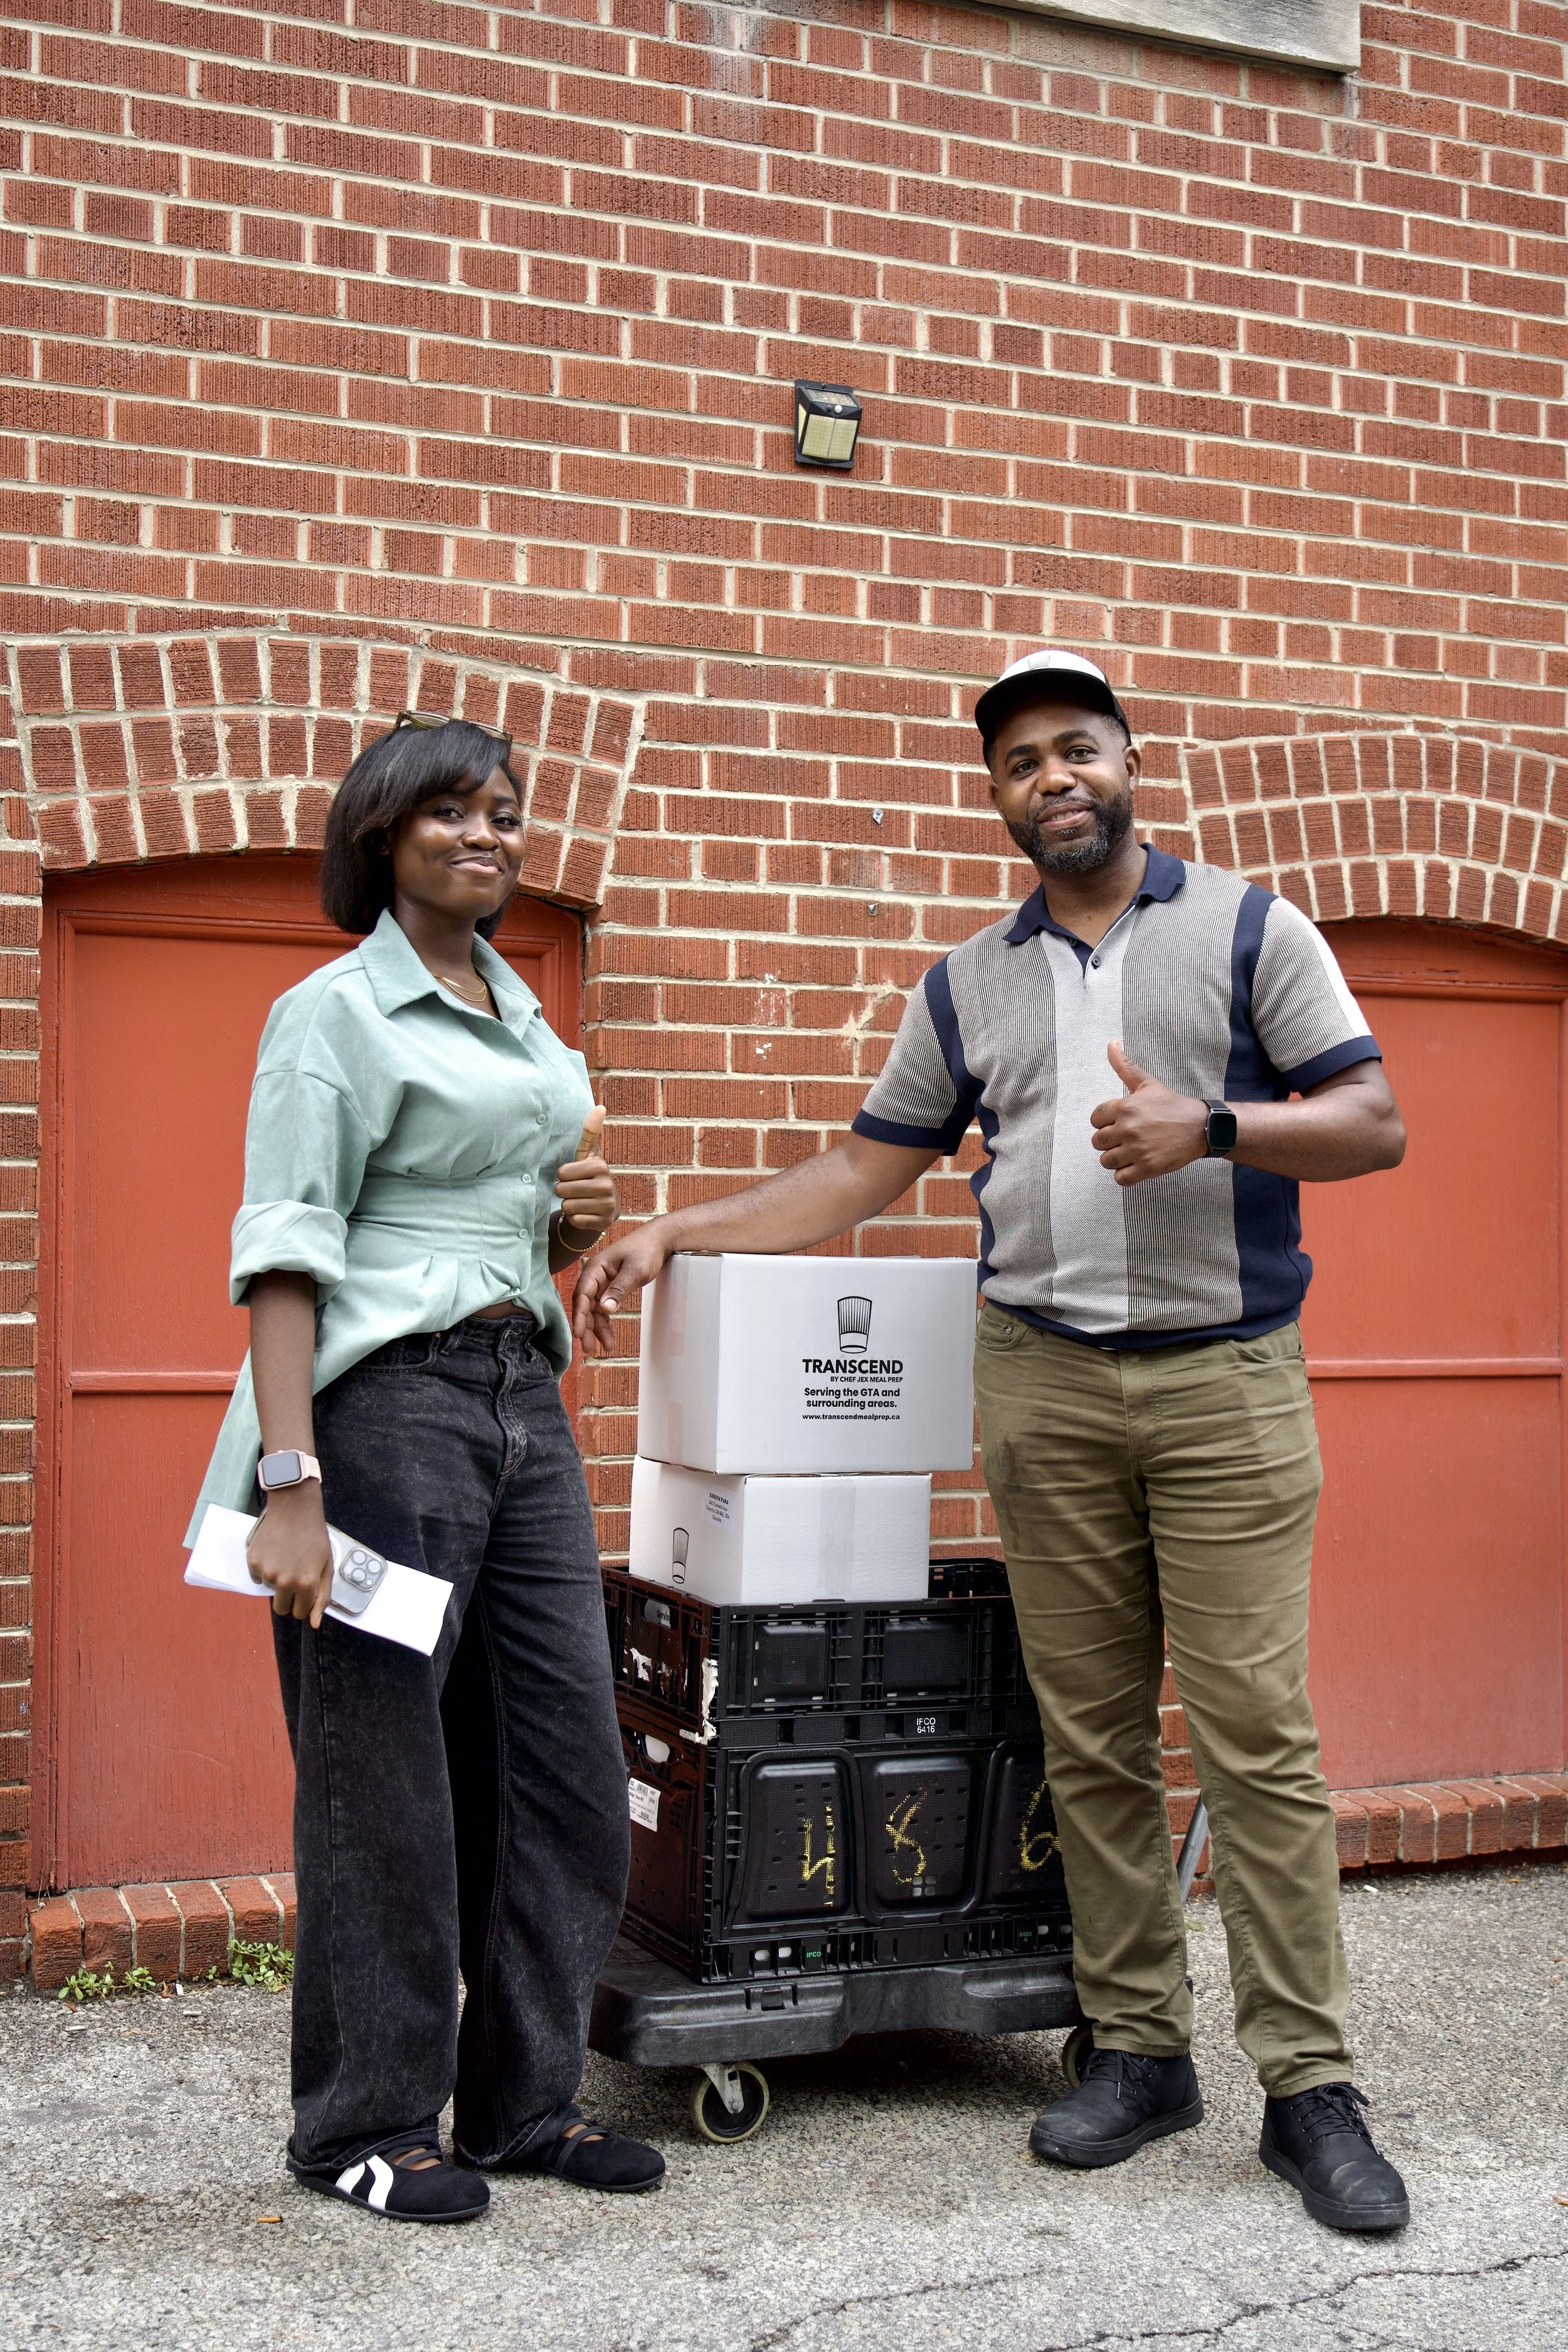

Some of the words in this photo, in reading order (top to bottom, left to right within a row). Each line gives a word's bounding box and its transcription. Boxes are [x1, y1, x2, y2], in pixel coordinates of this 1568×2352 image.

[802, 1359, 903, 1374] TRANSCEND
[805, 1387, 841, 1399] Serving
[843, 1388, 859, 1396] the
[861, 1388, 880, 1397] GTA
[881, 1388, 900, 1397] and
[807, 1399, 866, 1410] surrounding
[657, 1610, 670, 1621] Servin
[916, 1717, 936, 1725] IFCO
[917, 1725, 935, 1734] 6416
